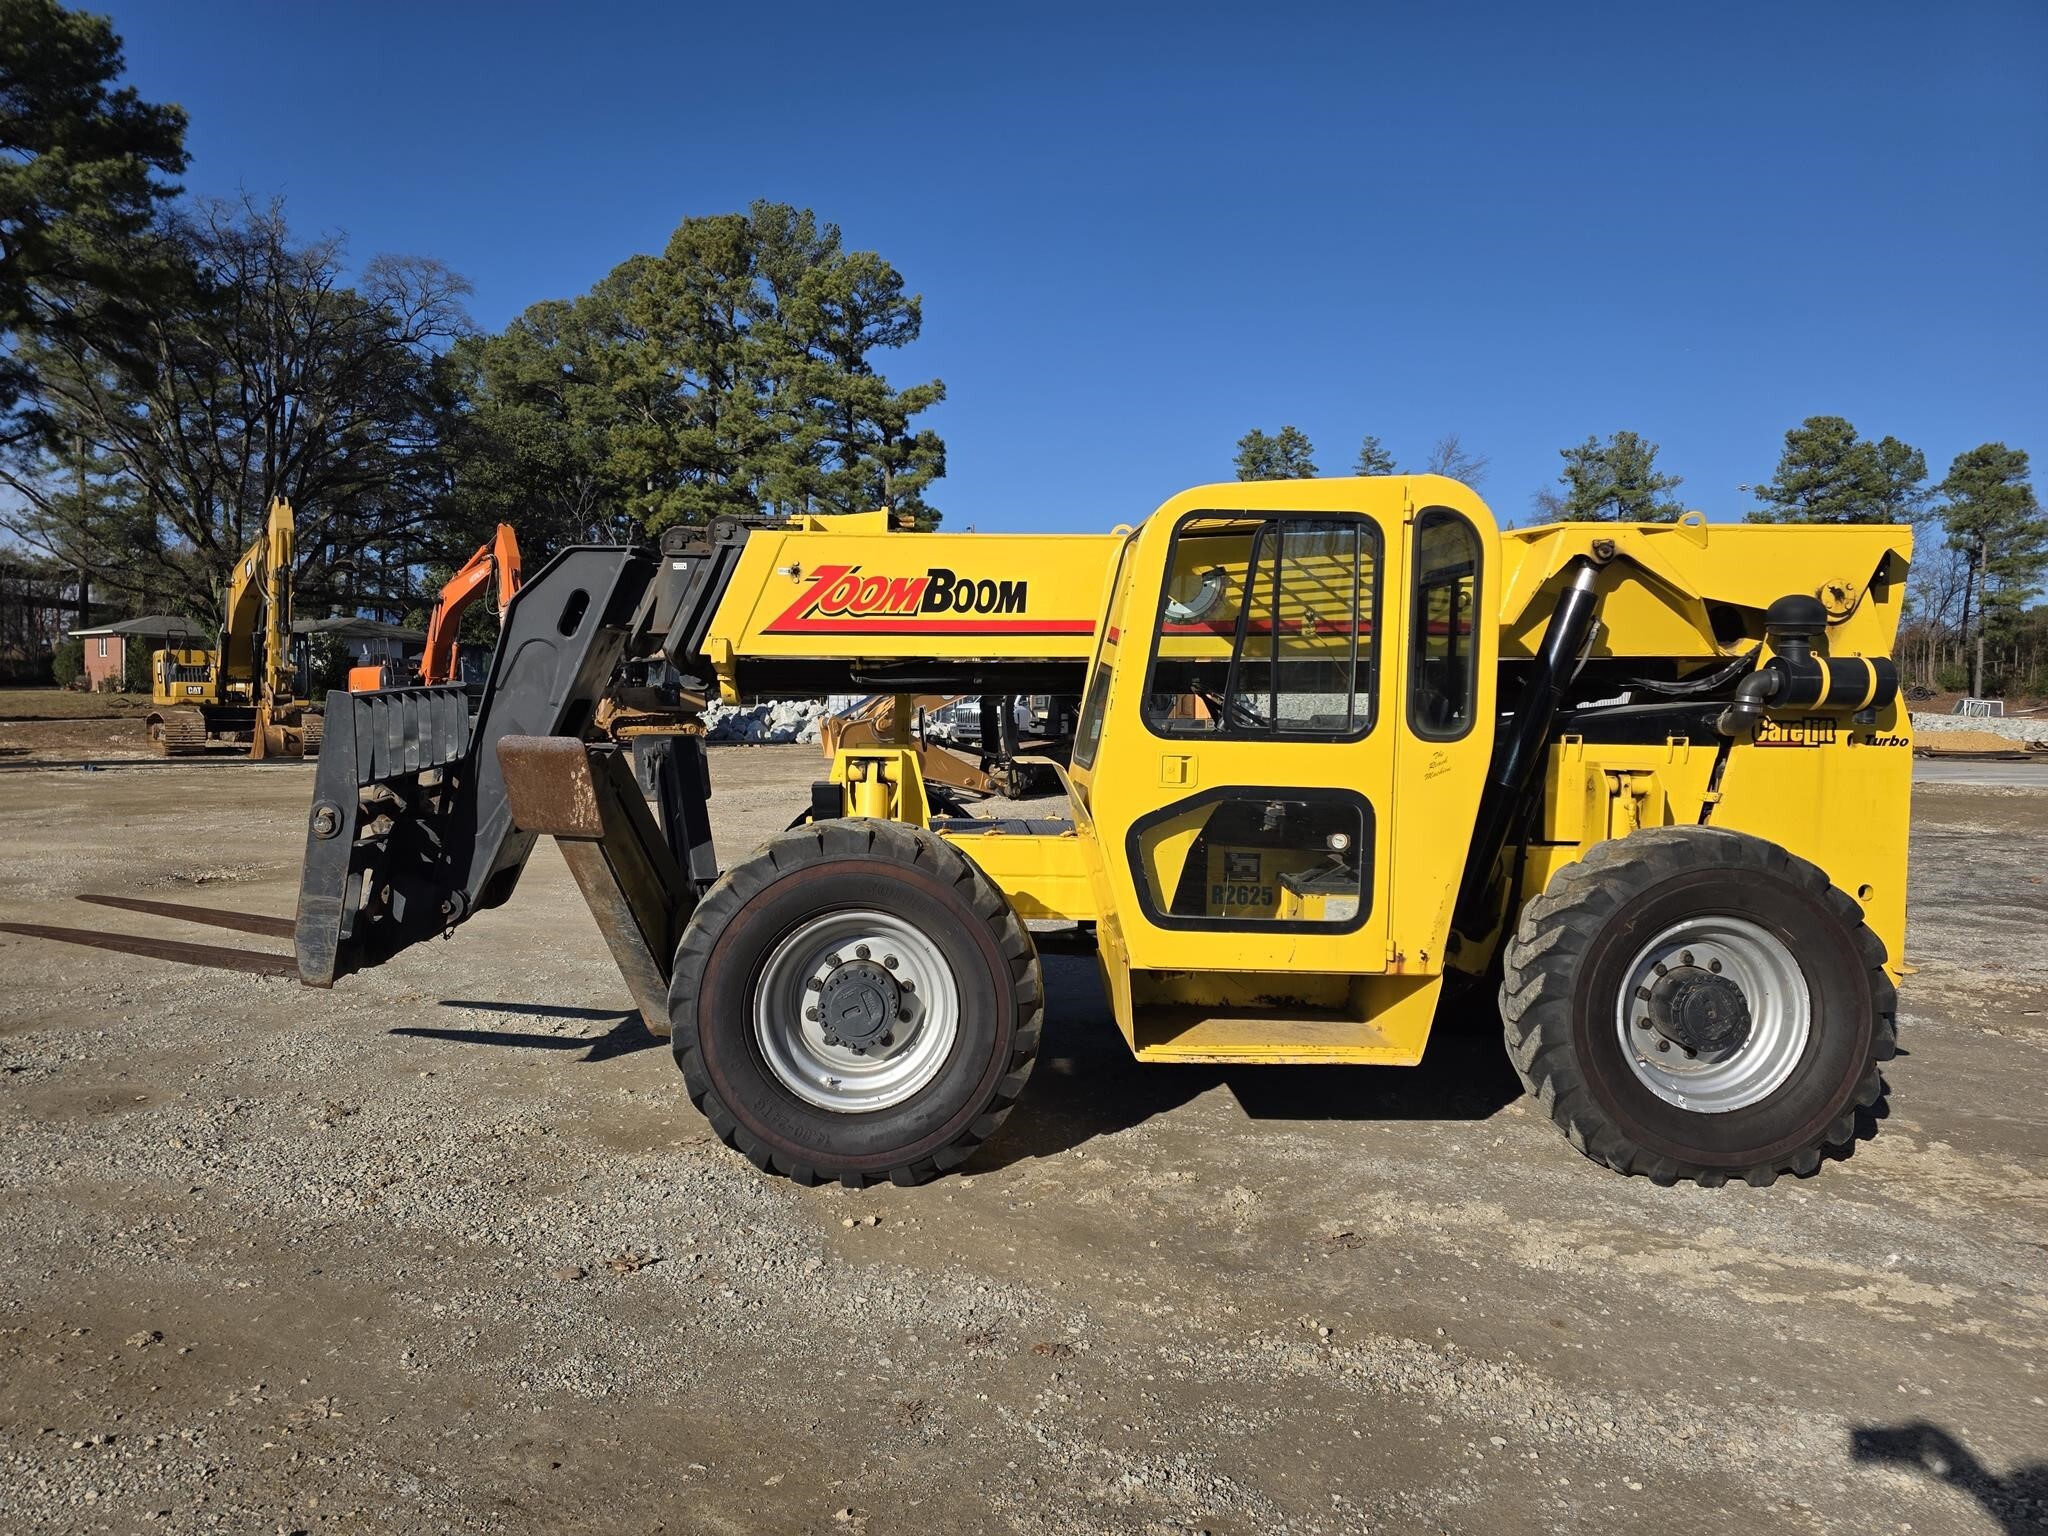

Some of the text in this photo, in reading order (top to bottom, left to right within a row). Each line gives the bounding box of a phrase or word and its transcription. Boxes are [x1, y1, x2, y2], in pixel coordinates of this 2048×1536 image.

[187, 686, 202, 695] CAT
[1753, 715, 1836, 747] CareLift
[1865, 734, 1909, 747] Turbo
[1211, 885, 1273, 906] R2625
